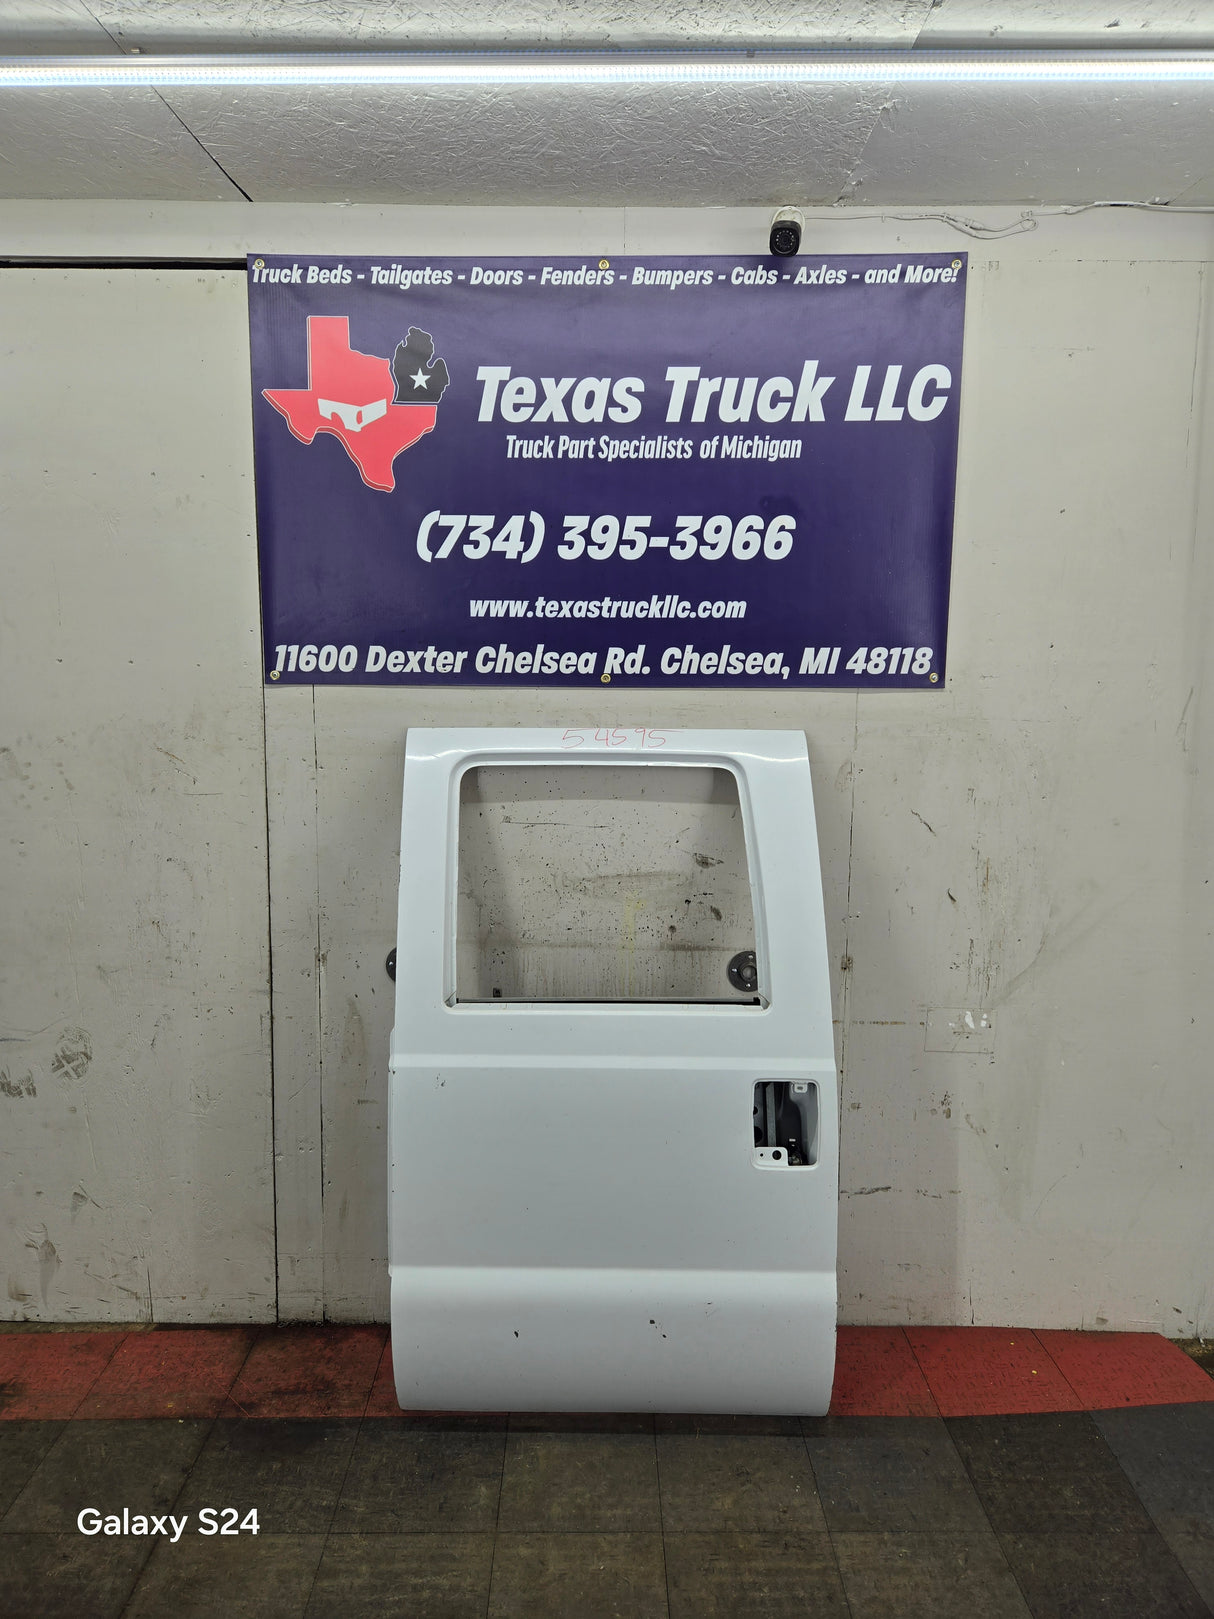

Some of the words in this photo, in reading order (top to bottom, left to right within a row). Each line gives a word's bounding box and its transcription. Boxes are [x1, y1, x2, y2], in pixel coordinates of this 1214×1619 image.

[252, 264, 302, 284] Truck
[306, 264, 353, 285] Beds
[370, 264, 454, 290] Tailgates
[469, 266, 524, 286] Doors
[540, 266, 615, 286] Fenders
[631, 266, 714, 290] Bumpers
[730, 265, 779, 286] Cabs
[793, 265, 848, 285] Axles
[864, 264, 902, 284] and
[904, 264, 958, 284] More!
[476, 365, 645, 424] Texas
[664, 359, 837, 423] Truck
[844, 363, 952, 422] LLC
[506, 434, 555, 459] Truck
[557, 435, 596, 459] Part
[597, 435, 694, 462] Specialists
[699, 435, 721, 460] of
[721, 435, 803, 462] Michigan
[416, 510, 546, 564] (734)
[557, 514, 796, 561] 395-3966
[469, 594, 748, 620] www.texastruckllc.com
[274, 644, 358, 673] 11600
[365, 645, 469, 674] Dexter
[475, 643, 598, 675] Chelsea
[603, 644, 651, 675] Rd.
[660, 644, 790, 680] Chelsea,
[798, 647, 842, 675] MI
[845, 646, 934, 675] 48118
